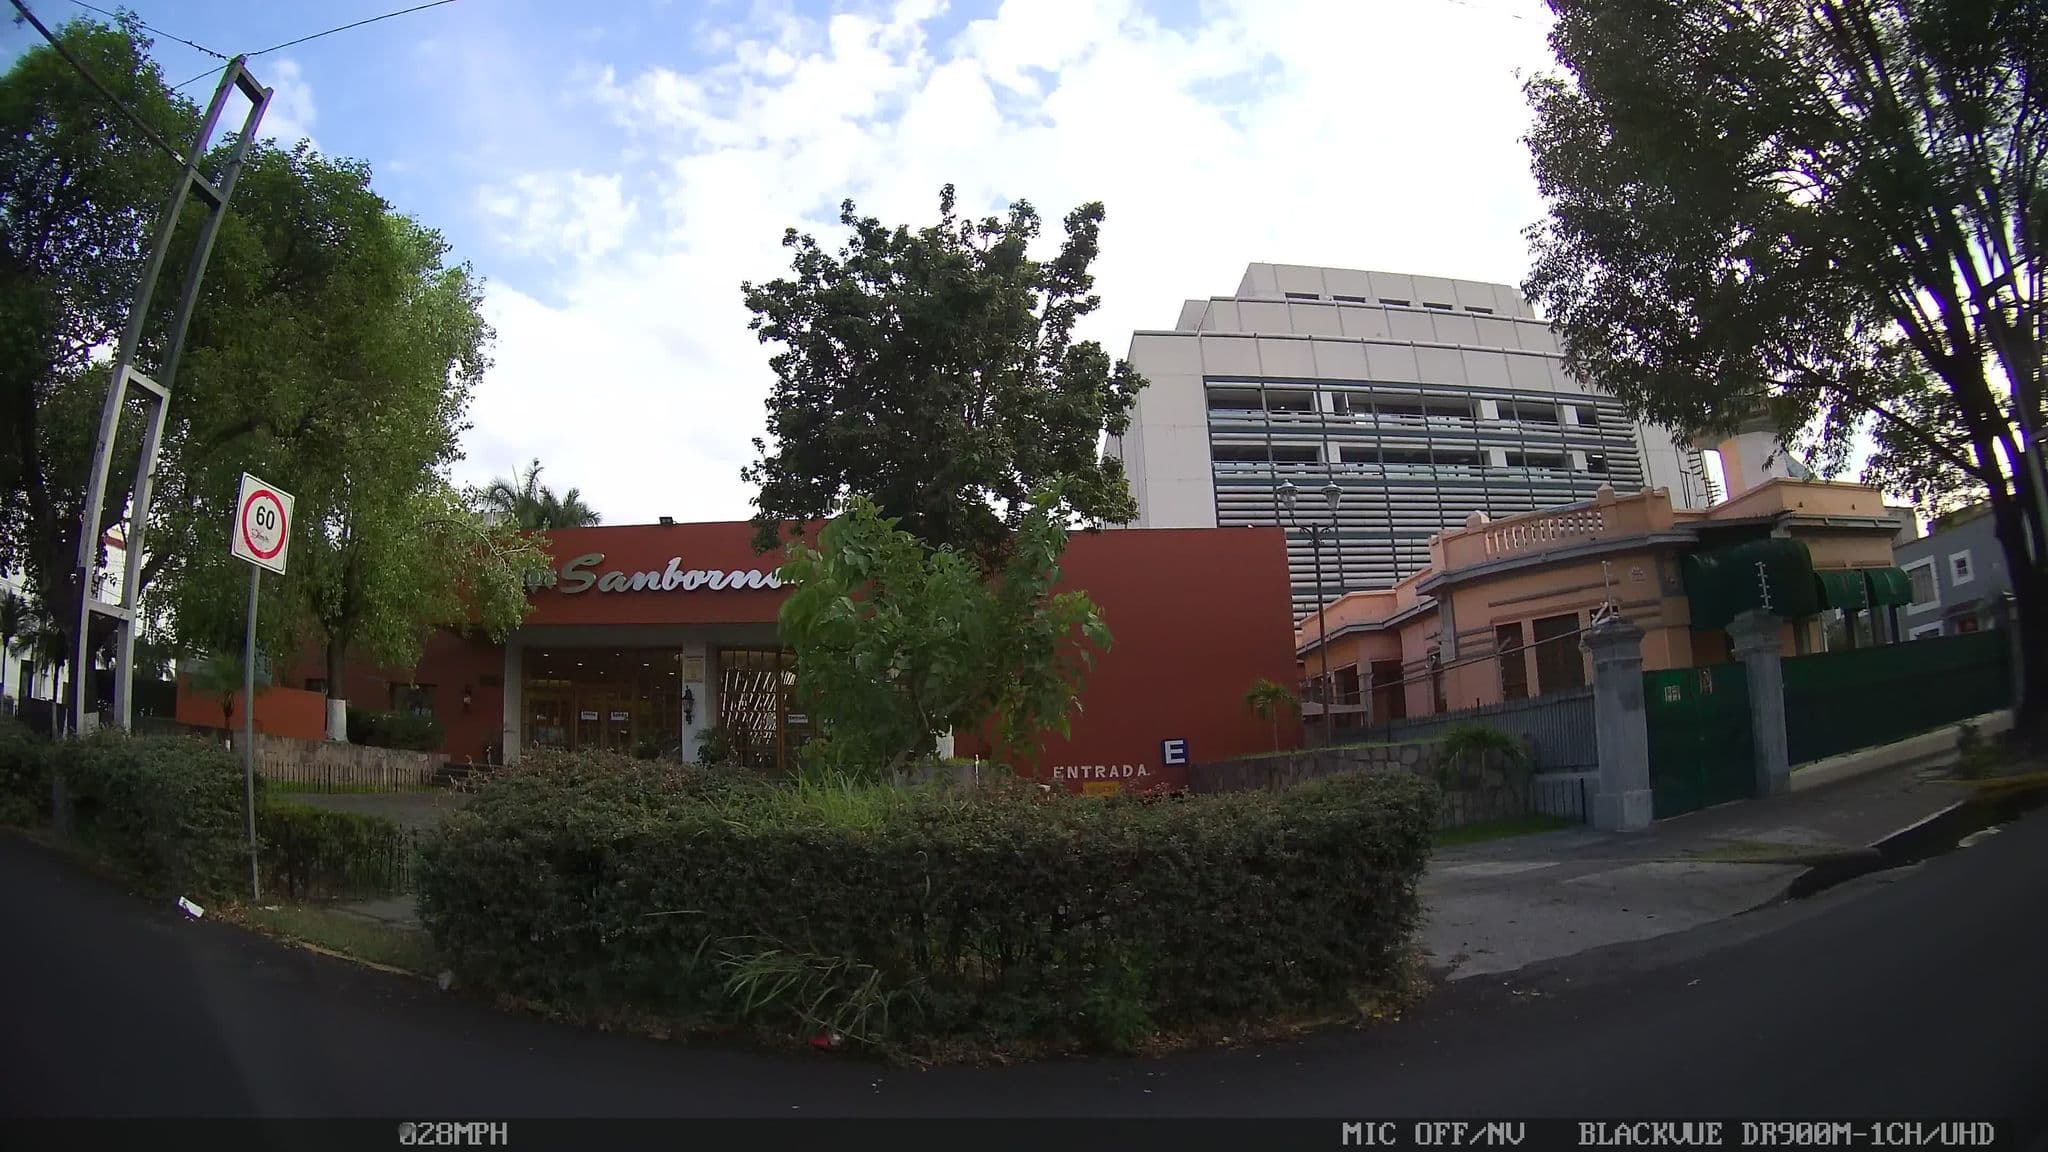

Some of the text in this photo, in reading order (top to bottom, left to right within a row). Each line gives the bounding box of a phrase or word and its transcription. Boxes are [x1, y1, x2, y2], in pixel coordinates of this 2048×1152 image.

[256, 505, 275, 530] 60
[1164, 739, 1186, 764] E
[1053, 764, 1147, 779] ENTRADA
